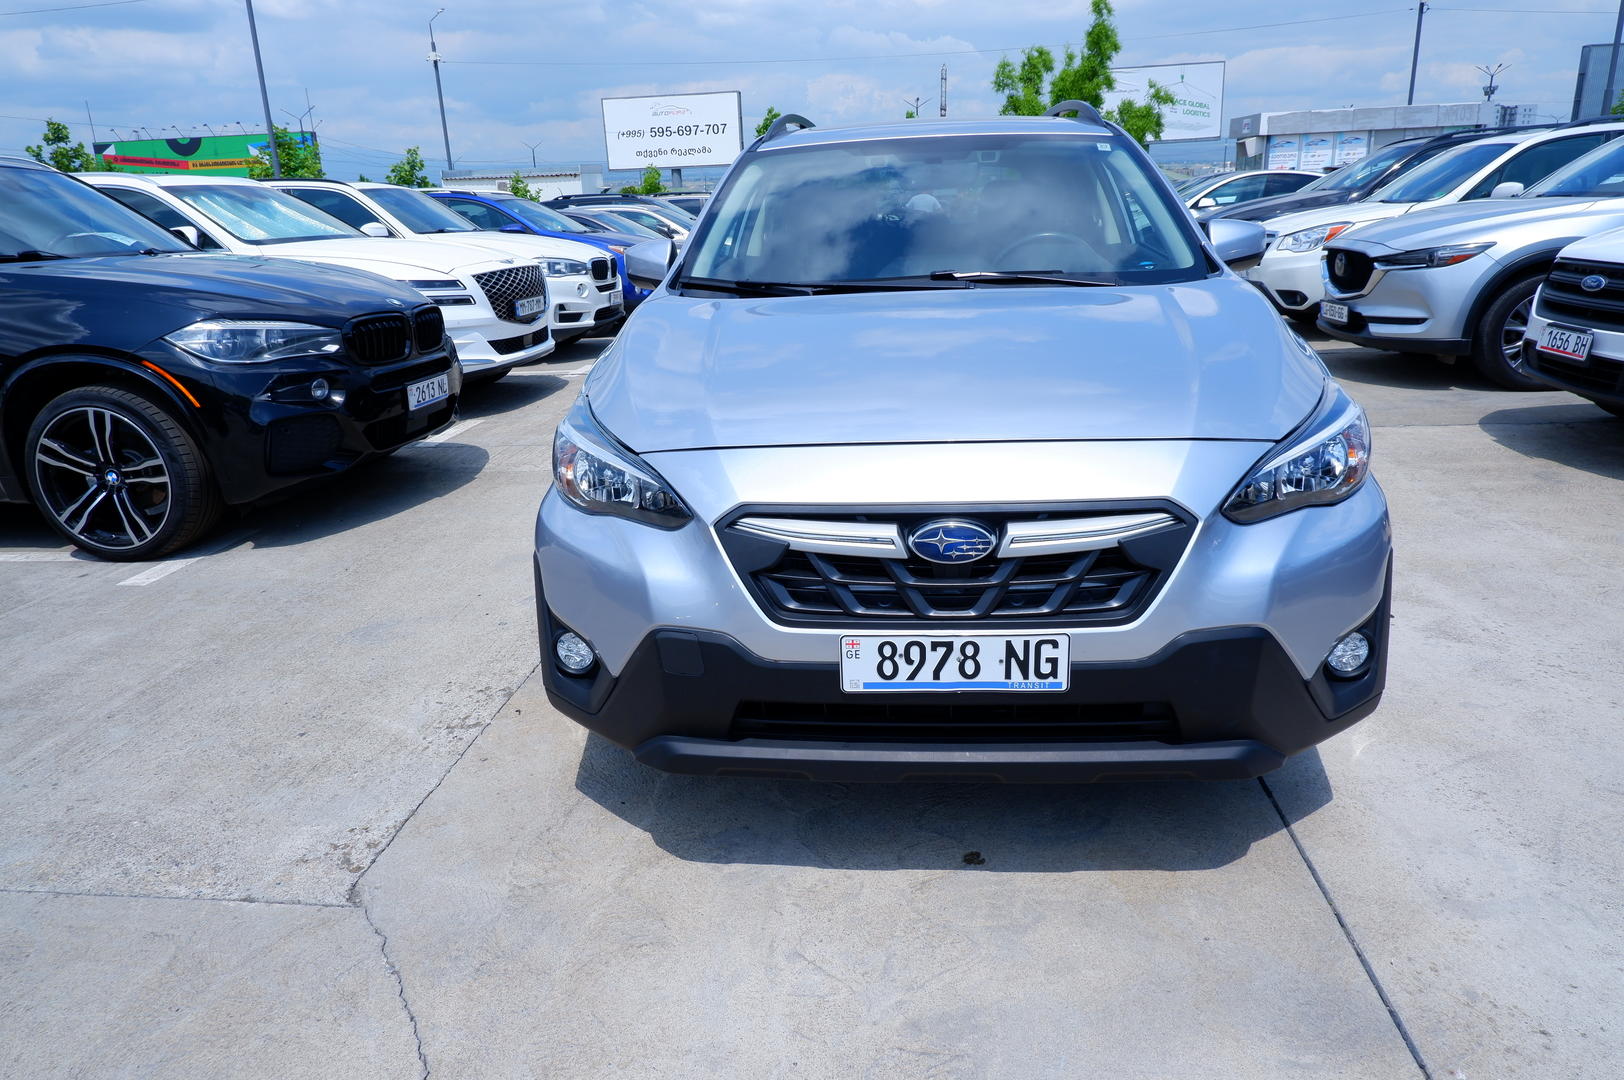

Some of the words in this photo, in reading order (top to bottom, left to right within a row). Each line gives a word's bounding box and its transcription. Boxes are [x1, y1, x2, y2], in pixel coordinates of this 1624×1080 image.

[1188, 100, 1210, 110] GLOBAL
[1183, 108, 1210, 118] LOGISTICS
[617, 129, 645, 140] (+995)
[649, 123, 727, 138] 595-697-707
[635, 147, 668, 158] თქვენი
[670, 146, 712, 157] რეკლამა
[1547, 330, 1572, 351] 1656
[1572, 335, 1589, 356] BH
[415, 381, 436, 404] 2613
[845, 650, 861, 659] GE
[876, 640, 981, 681] 8978
[1004, 639, 1060, 681] NG
